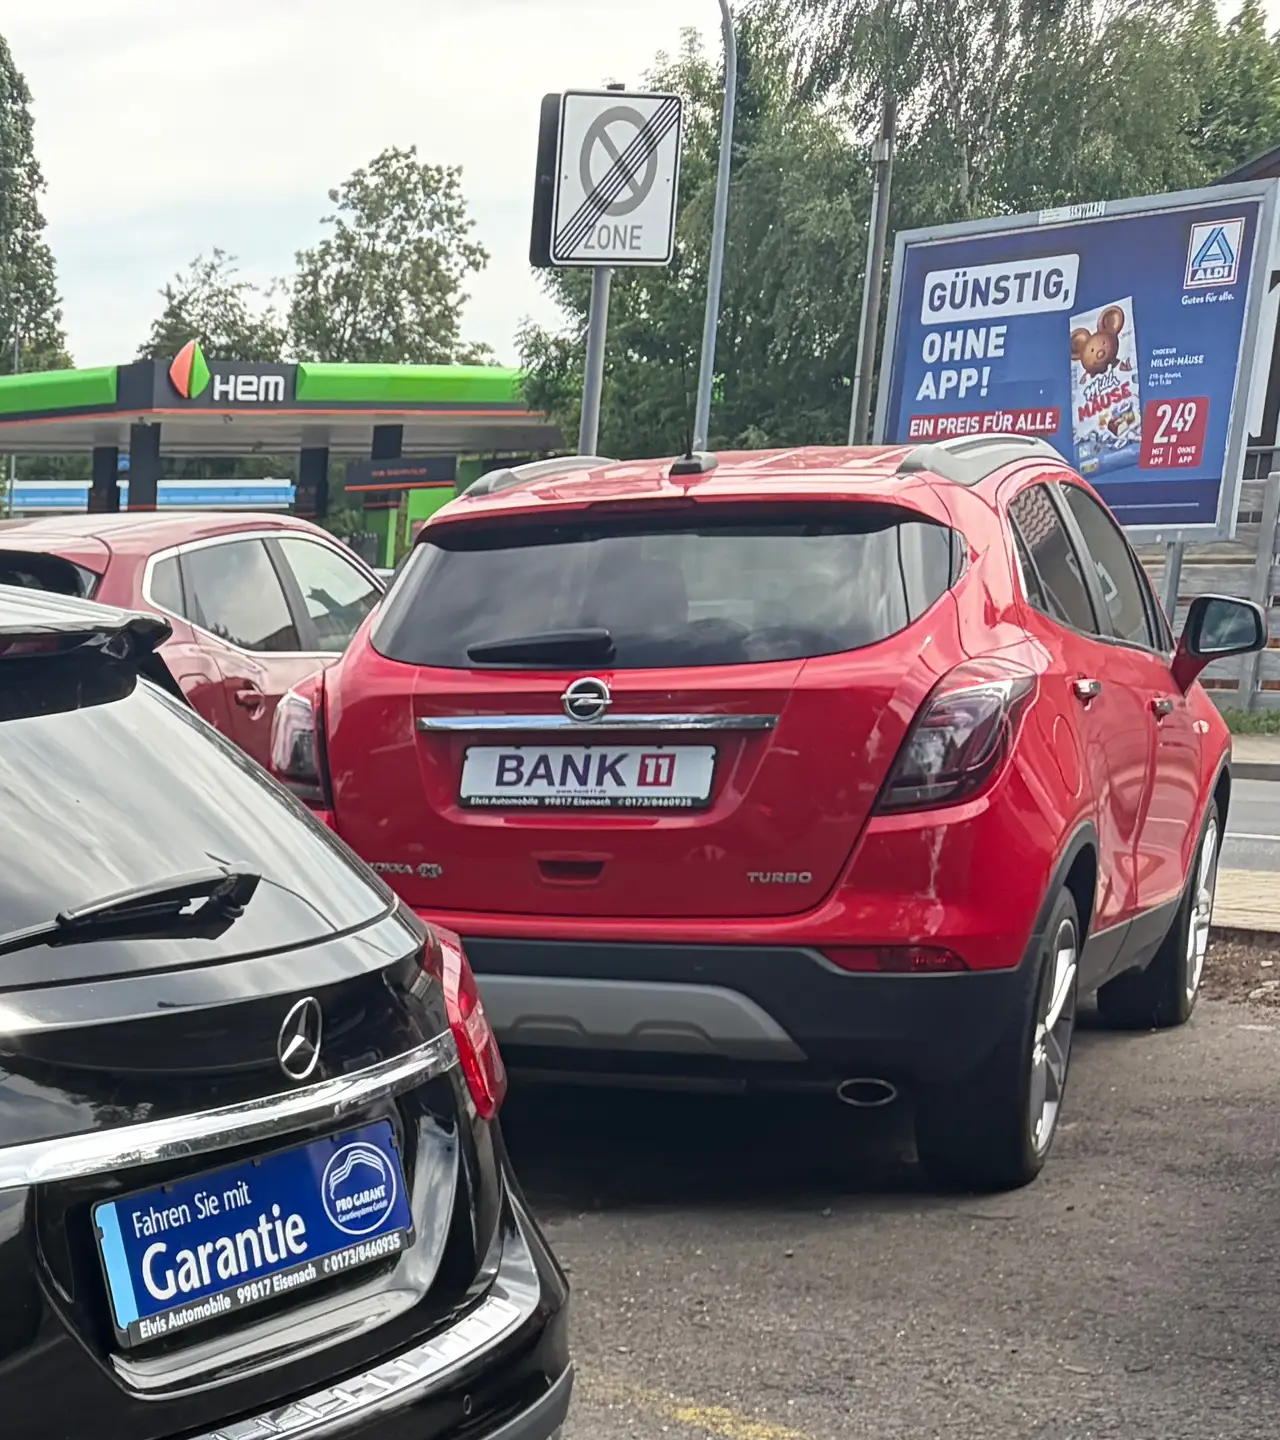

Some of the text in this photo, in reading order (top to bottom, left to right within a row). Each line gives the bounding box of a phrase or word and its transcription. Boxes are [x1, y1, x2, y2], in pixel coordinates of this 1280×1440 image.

[583, 224, 643, 250] ZONE
[1193, 266, 1230, 280] ALDI
[928, 268, 1069, 312] GÜNSTIG,
[1181, 291, 1234, 305] Gutes für alle.
[922, 325, 1007, 364] OHNE
[1151, 355, 1204, 368] MILCH-MÄUSE
[916, 366, 990, 401] APP!
[909, 410, 1057, 437] EIN PREIS FÜR ALLE.
[1153, 402, 1197, 444] 2.49
[1149, 457, 1163, 465] APP
[1151, 447, 1164, 455] MIT
[1177, 446, 1196, 454] OHNE
[1178, 455, 1193, 464] APP
[495, 753, 671, 787] BANK 11
[747, 871, 812, 884] TURBO
[132, 1180, 253, 1239] Fahren Sie mit
[336, 1184, 386, 1213] PRO GARANT
[142, 1203, 308, 1301] Garantie
[139, 1233, 401, 1339] Elvis Automobile 99817 Eisenach 0173/8460935
